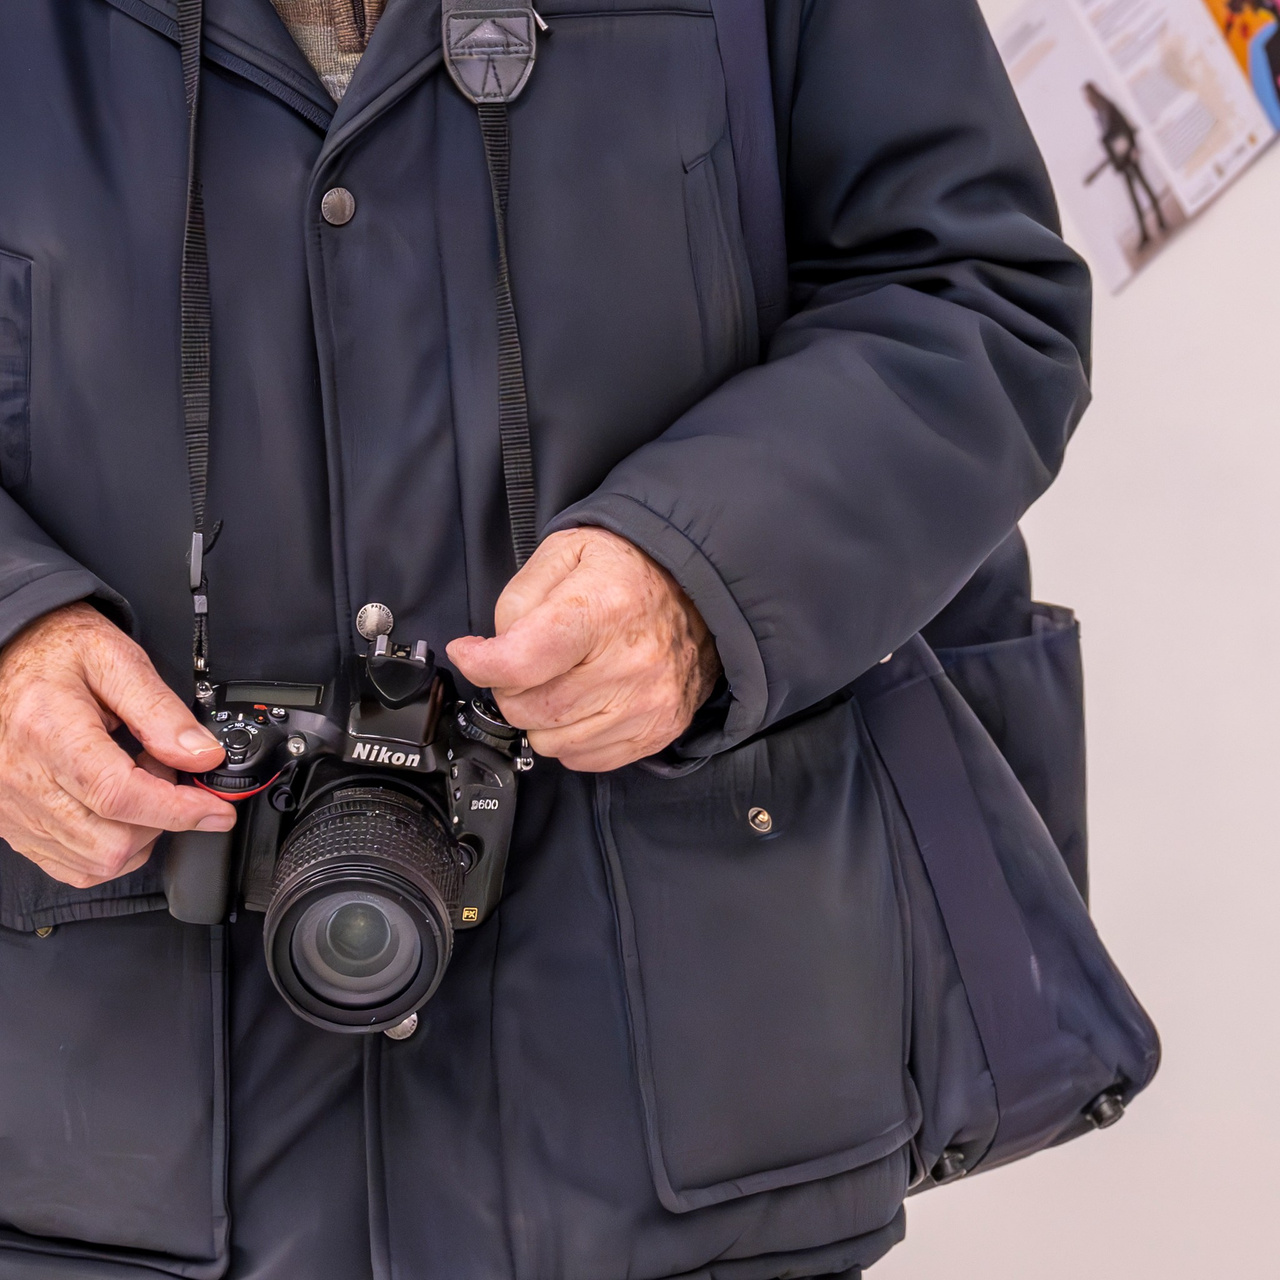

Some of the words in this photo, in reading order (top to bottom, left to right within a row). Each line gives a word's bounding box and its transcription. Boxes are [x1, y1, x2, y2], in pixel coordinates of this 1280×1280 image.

[245, 725, 259, 735] OFF
[351, 742, 421, 767] Nikon
[470, 799, 499, 810] D600
[464, 909, 477, 919] FX
